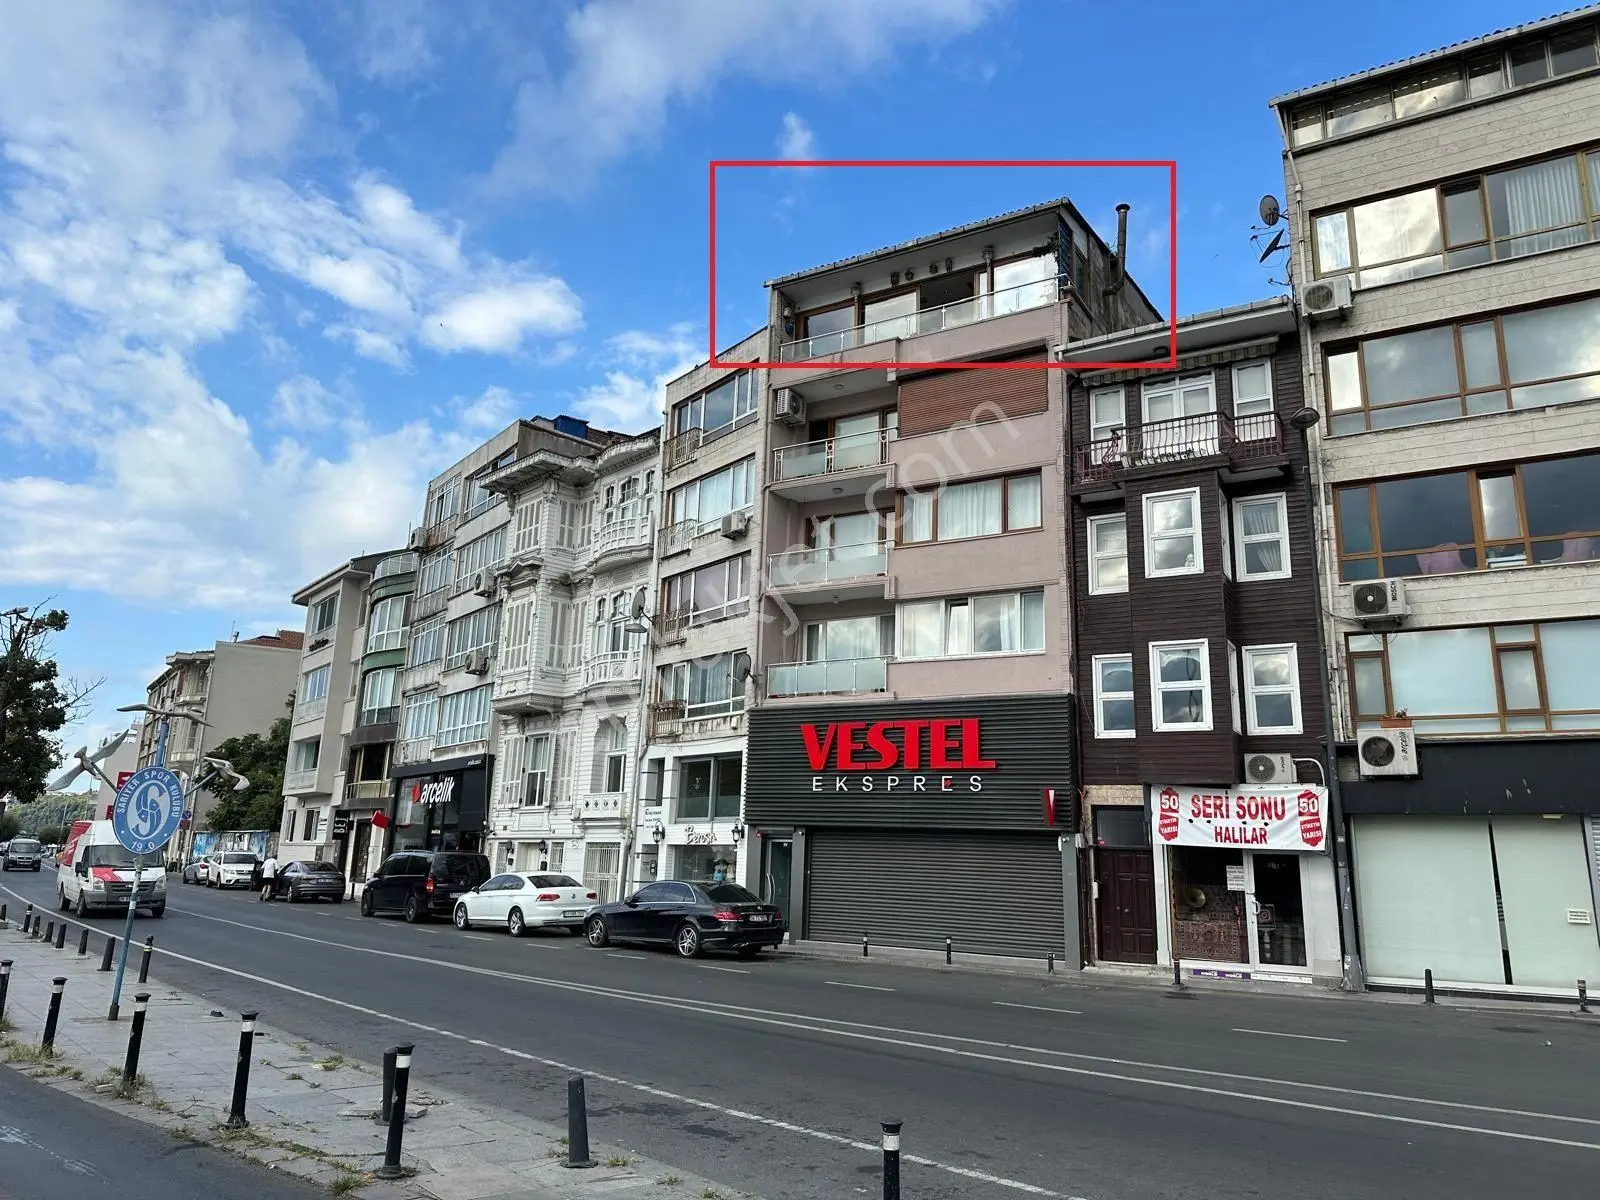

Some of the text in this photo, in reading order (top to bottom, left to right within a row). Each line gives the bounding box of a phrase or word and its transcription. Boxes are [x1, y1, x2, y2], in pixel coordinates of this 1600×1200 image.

[800, 718, 997, 771] VESTEL
[117, 778, 140, 812] SARIYER
[143, 771, 170, 783] SPOR
[420, 776, 455, 808] arçelik
[812, 775, 982, 792] EKSPRES
[1161, 795, 1179, 810] 50
[1191, 790, 1286, 821] SERİ SONU
[1299, 797, 1319, 813] 50
[1161, 826, 1178, 834] YARISI
[1214, 826, 1268, 845] HALILAR
[1302, 830, 1322, 839] YARISI
[131, 841, 155, 852] 190
